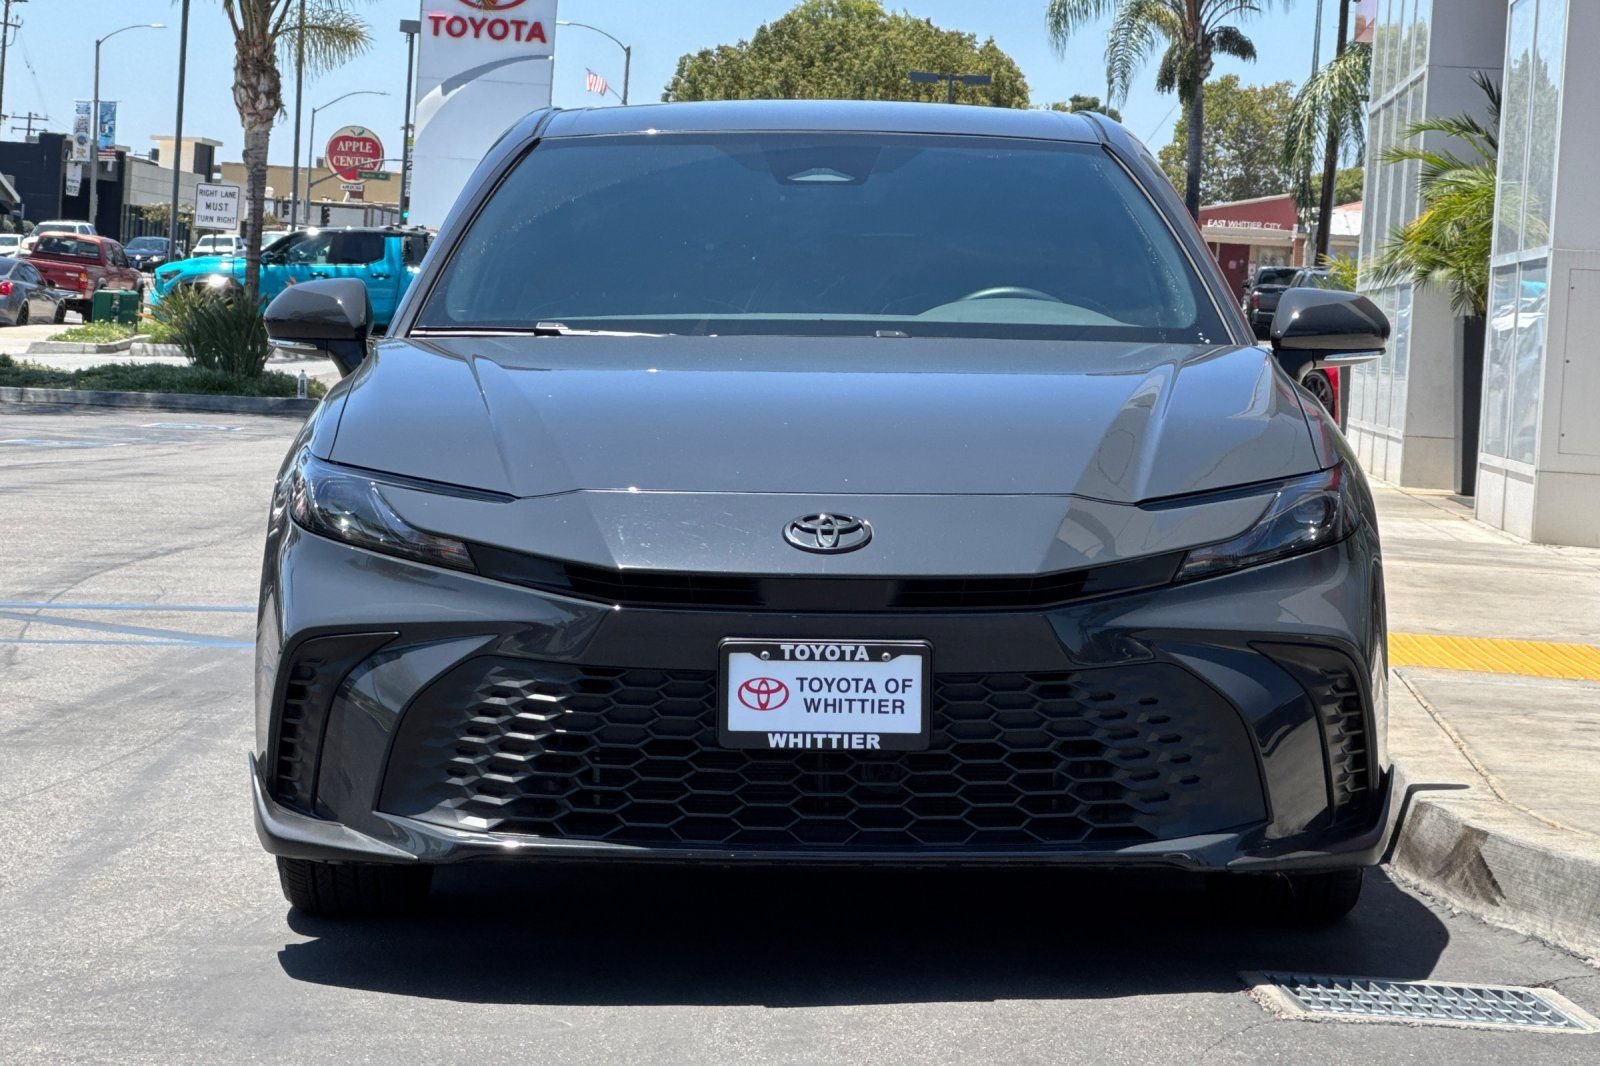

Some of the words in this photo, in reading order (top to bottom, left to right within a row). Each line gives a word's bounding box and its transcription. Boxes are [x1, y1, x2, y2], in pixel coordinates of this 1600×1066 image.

[428, 14, 547, 43] TOYOTA
[336, 140, 373, 153] APPLE
[333, 155, 374, 168] CENTER
[199, 189, 218, 197] RIGHT
[205, 202, 228, 211] MUST
[197, 214, 214, 222] TURN
[216, 215, 235, 224] RIGHT
[1207, 219, 1226, 228] EAST
[1228, 220, 1262, 229] WHITTIER
[1264, 222, 1281, 230] CITY
[780, 644, 869, 661] TOYOTA
[796, 677, 876, 693] TOYOTA
[885, 678, 913, 694] OF
[803, 698, 905, 714] WHITTIER
[768, 733, 881, 749] WHITTIER
